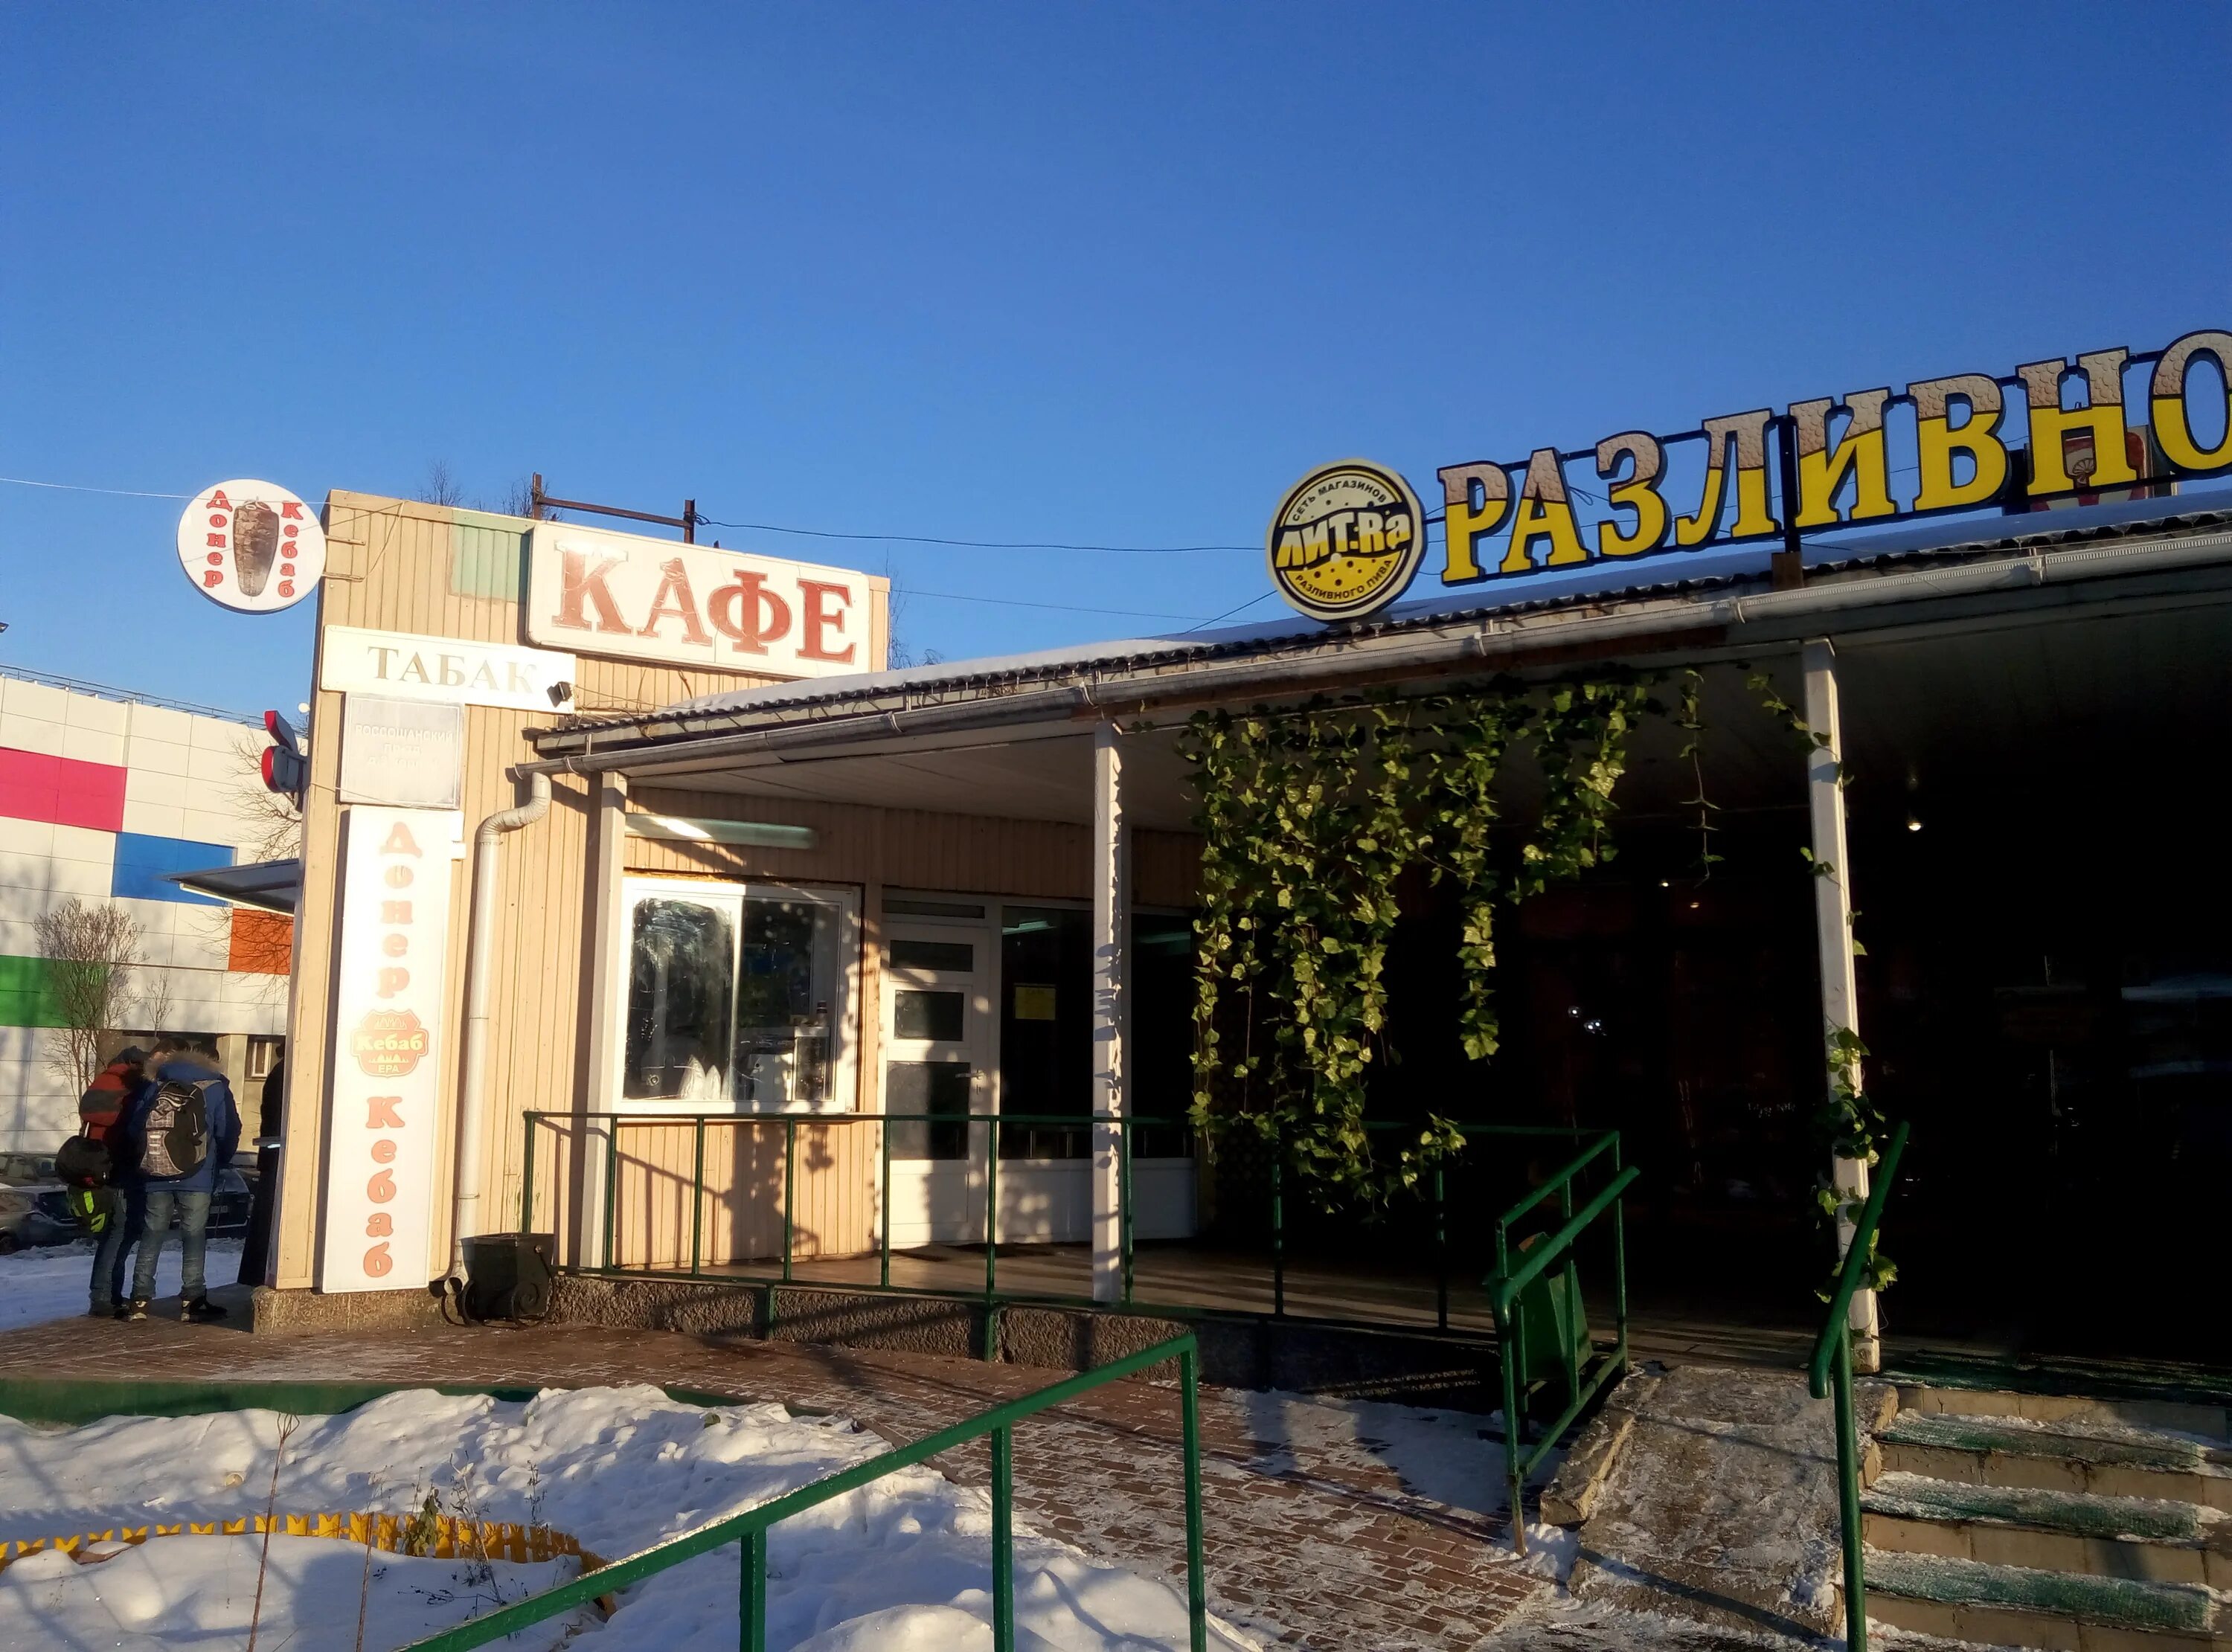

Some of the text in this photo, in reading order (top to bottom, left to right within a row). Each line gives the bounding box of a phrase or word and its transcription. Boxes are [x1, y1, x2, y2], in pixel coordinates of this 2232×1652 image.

[1437, 329, 2232, 586] РАЗЛИВНО
[1292, 480, 1388, 522] СЕТЬ МАГАЗИНОВ
[278, 501, 304, 598] Кебаб
[1295, 559, 1392, 600] РАЗЛИВНОГО ПИВА
[551, 541, 856, 663] КАФЕ
[367, 646, 537, 695] ТАБАК
[355, 724, 454, 744] РОССОШАНСКИЙ
[375, 821, 423, 999] Донер
[355, 1032, 423, 1051] Кебаб
[363, 1096, 405, 1278] Кебаб
